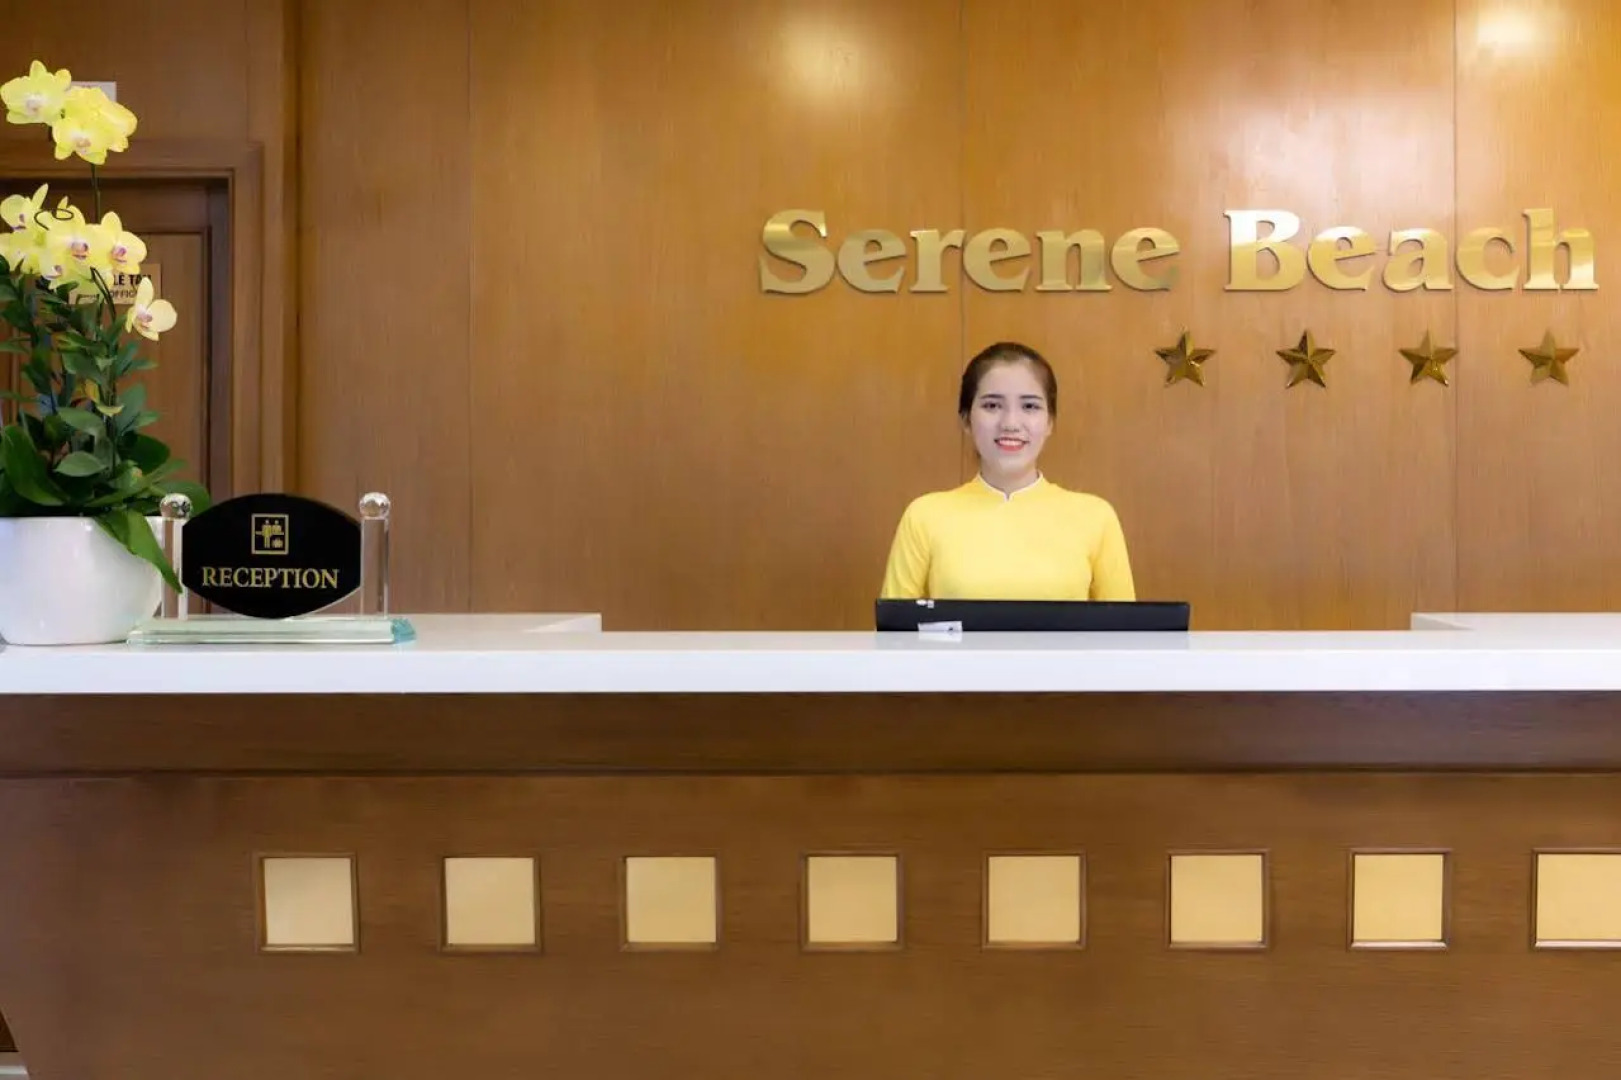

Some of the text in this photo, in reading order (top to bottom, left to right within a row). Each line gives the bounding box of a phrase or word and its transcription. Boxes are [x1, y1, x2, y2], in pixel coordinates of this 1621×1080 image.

[759, 208, 1599, 294] Serene Beach
[201, 566, 340, 590] RECEPTION
